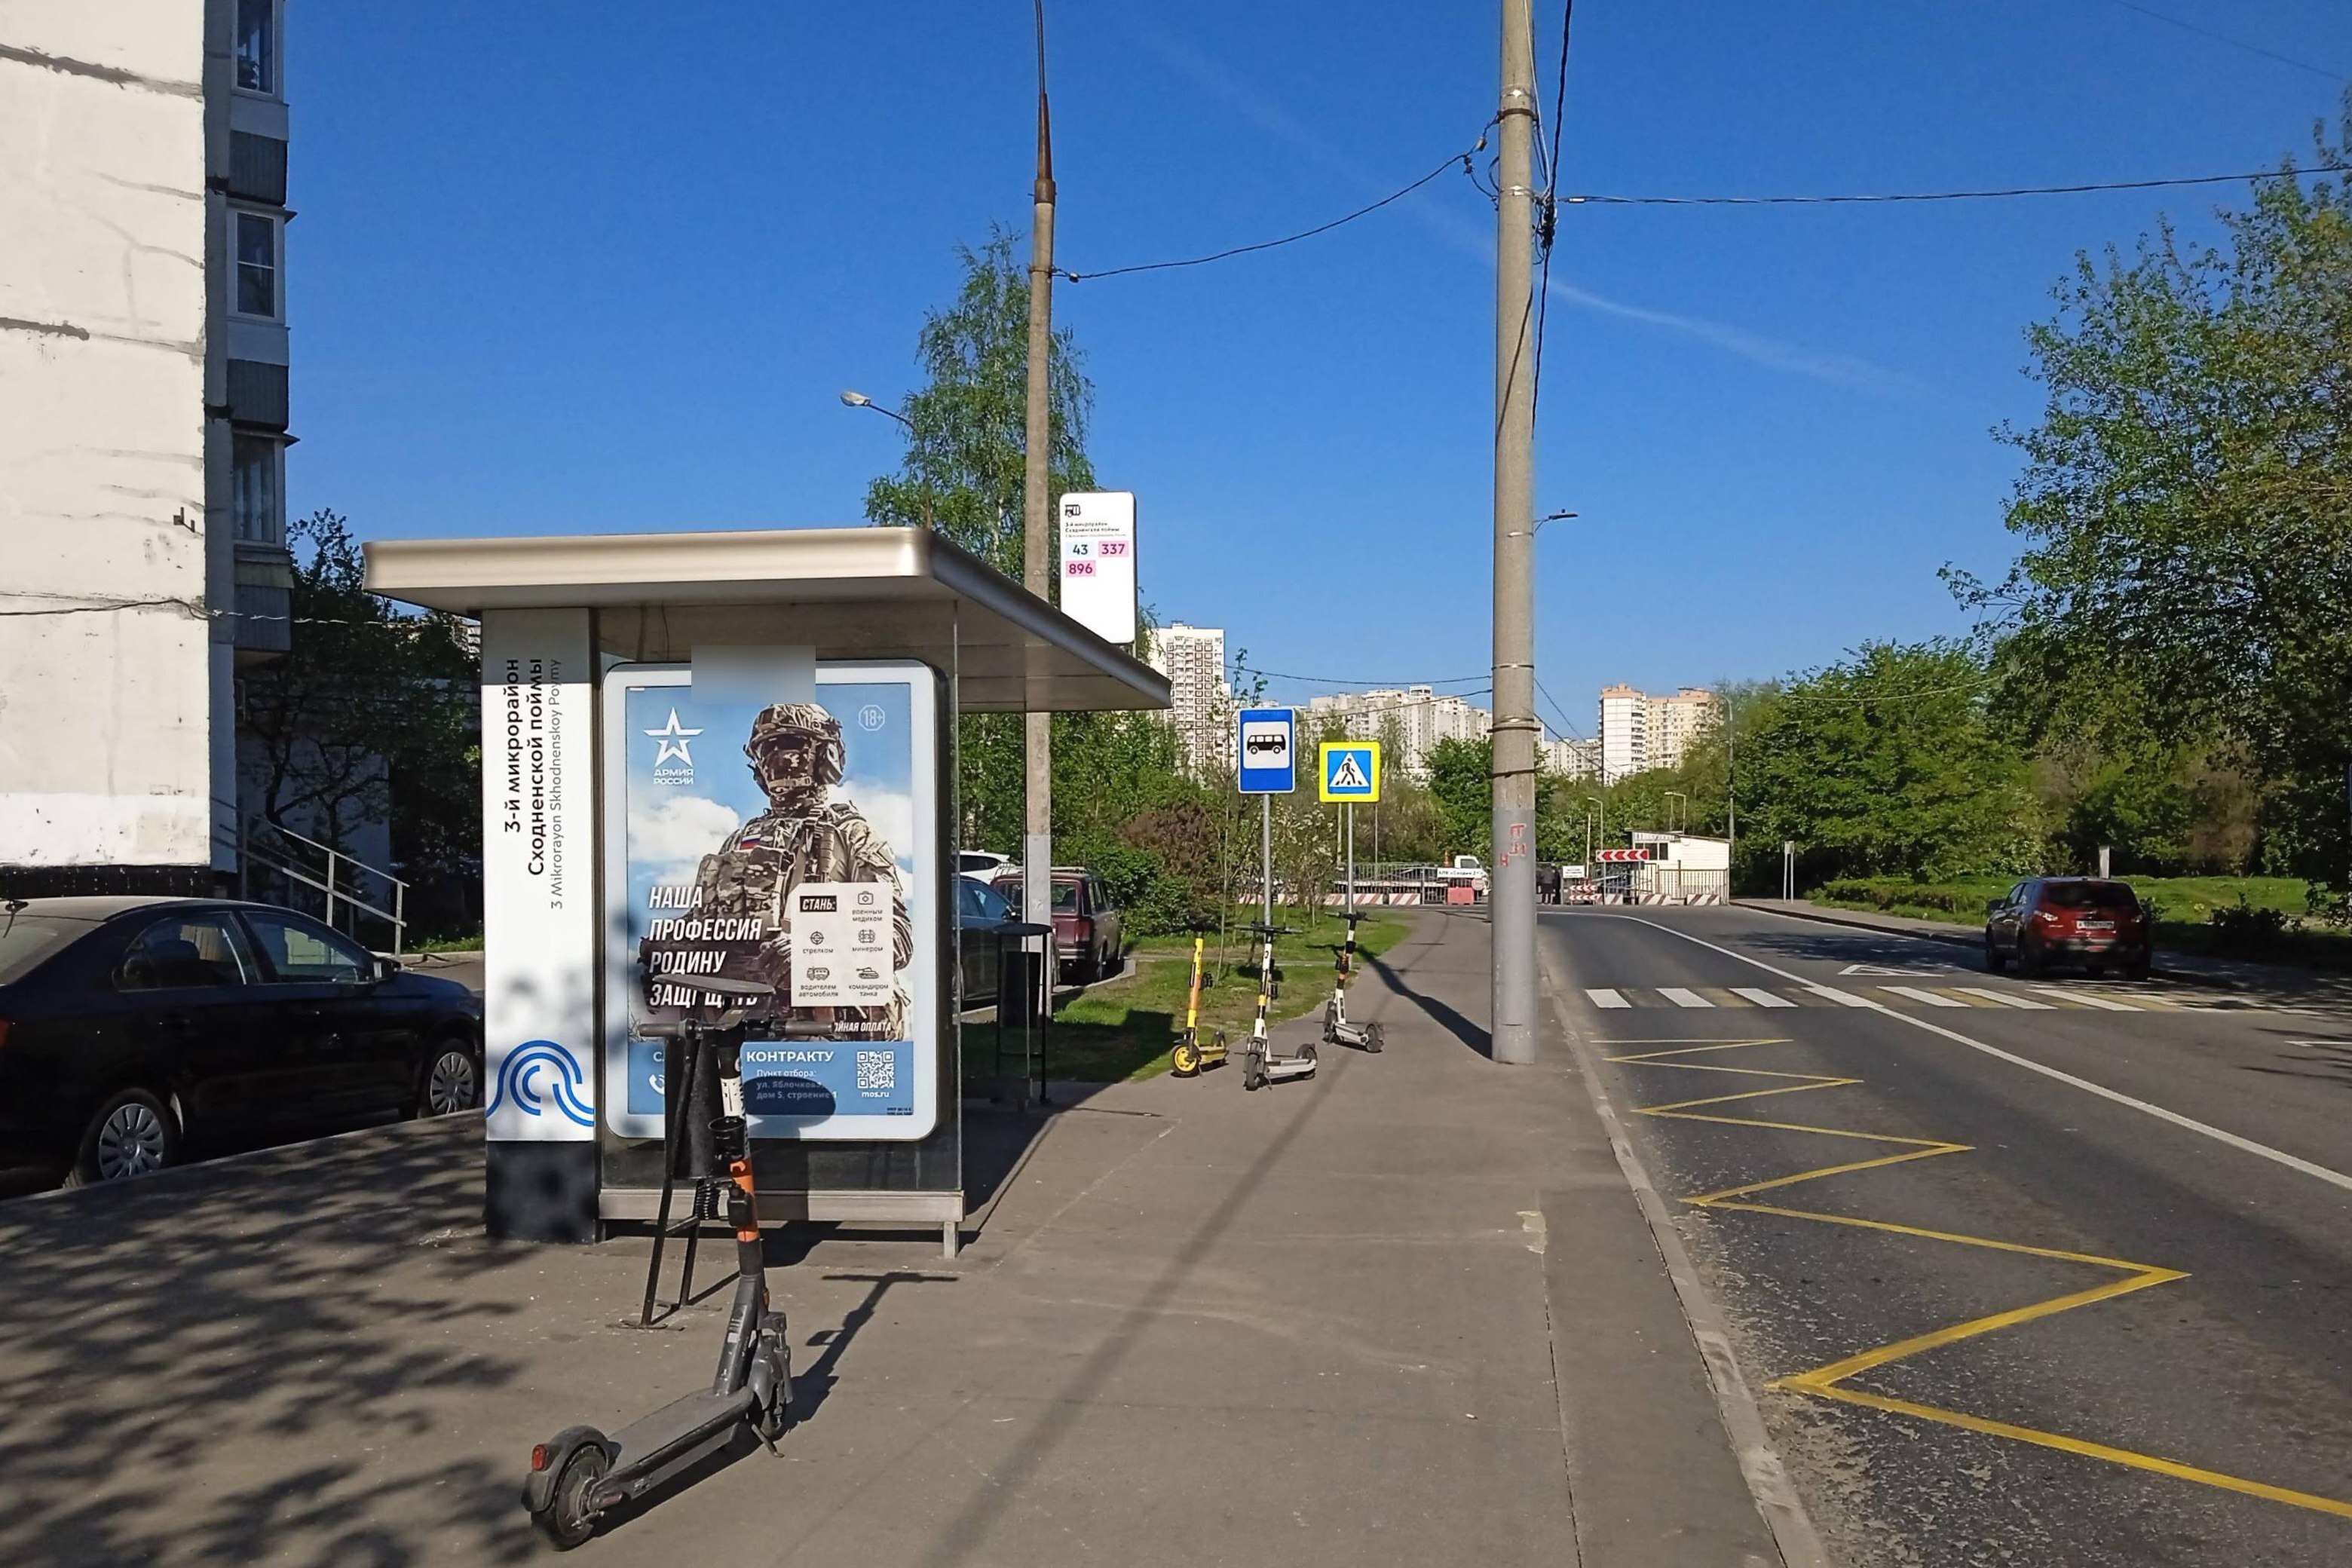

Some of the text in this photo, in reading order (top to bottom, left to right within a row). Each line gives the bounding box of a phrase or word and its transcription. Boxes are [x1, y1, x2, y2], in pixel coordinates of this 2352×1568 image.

[1073, 544, 1088, 555] 43
[1101, 543, 1125, 555] 337
[1068, 563, 1093, 574] 896
[863, 709, 883, 727] 18+
[503, 659, 523, 833] 3-й микрорайон
[525, 659, 547, 875] Сходненской поймы
[654, 768, 694, 777] АРМИЯ
[548, 658, 565, 909] 3 Mikrorayon Skhodnenskoy Poymy
[653, 777, 694, 786] РОССИИ
[648, 886, 703, 908] НАША
[801, 898, 836, 911] СТАНЬ:
[648, 918, 763, 942] ПРОФЕССИЯ
[648, 951, 727, 975] РОДИНУ
[860, 1021, 892, 1033] ОПЛАТА
[746, 1051, 835, 1063] КОНТРАКТУ
[756, 1069, 782, 1078] Пункт
[787, 1092, 830, 1101] строение
